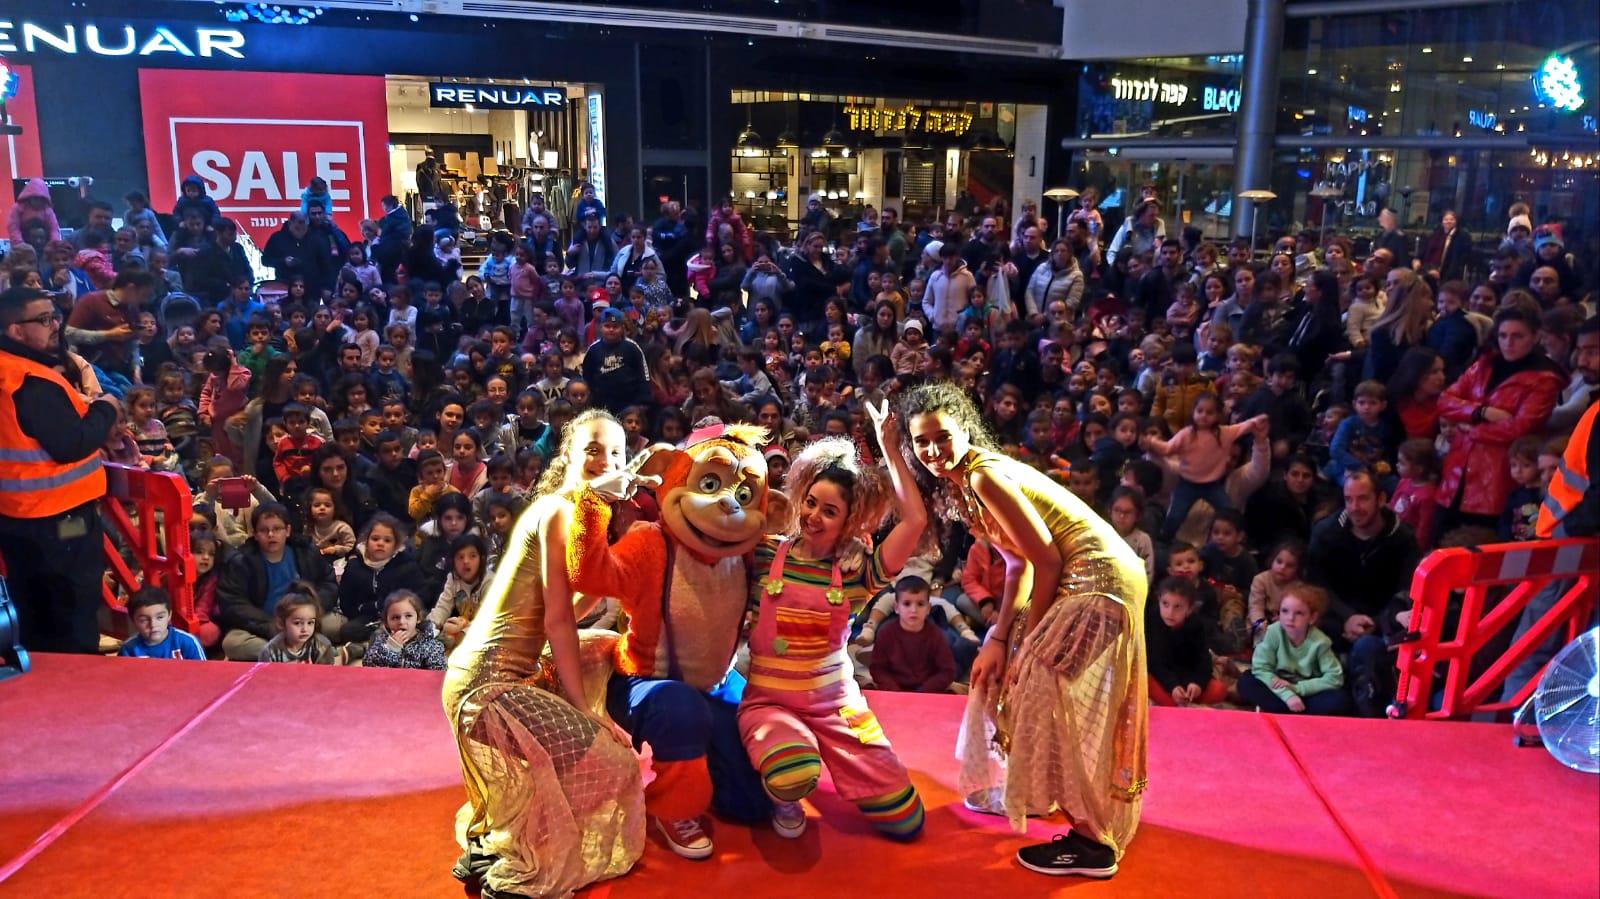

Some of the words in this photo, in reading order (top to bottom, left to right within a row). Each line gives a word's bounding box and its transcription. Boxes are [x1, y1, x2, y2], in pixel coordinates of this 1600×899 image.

[435, 88, 562, 106] RENUAR
[1111, 77, 1159, 101] לנדוור
[1160, 82, 1188, 106] קפה
[843, 105, 921, 131] לנדוור
[925, 110, 973, 136] קפה
[191, 150, 350, 201] SALE
[251, 217, 278, 228] עונה
